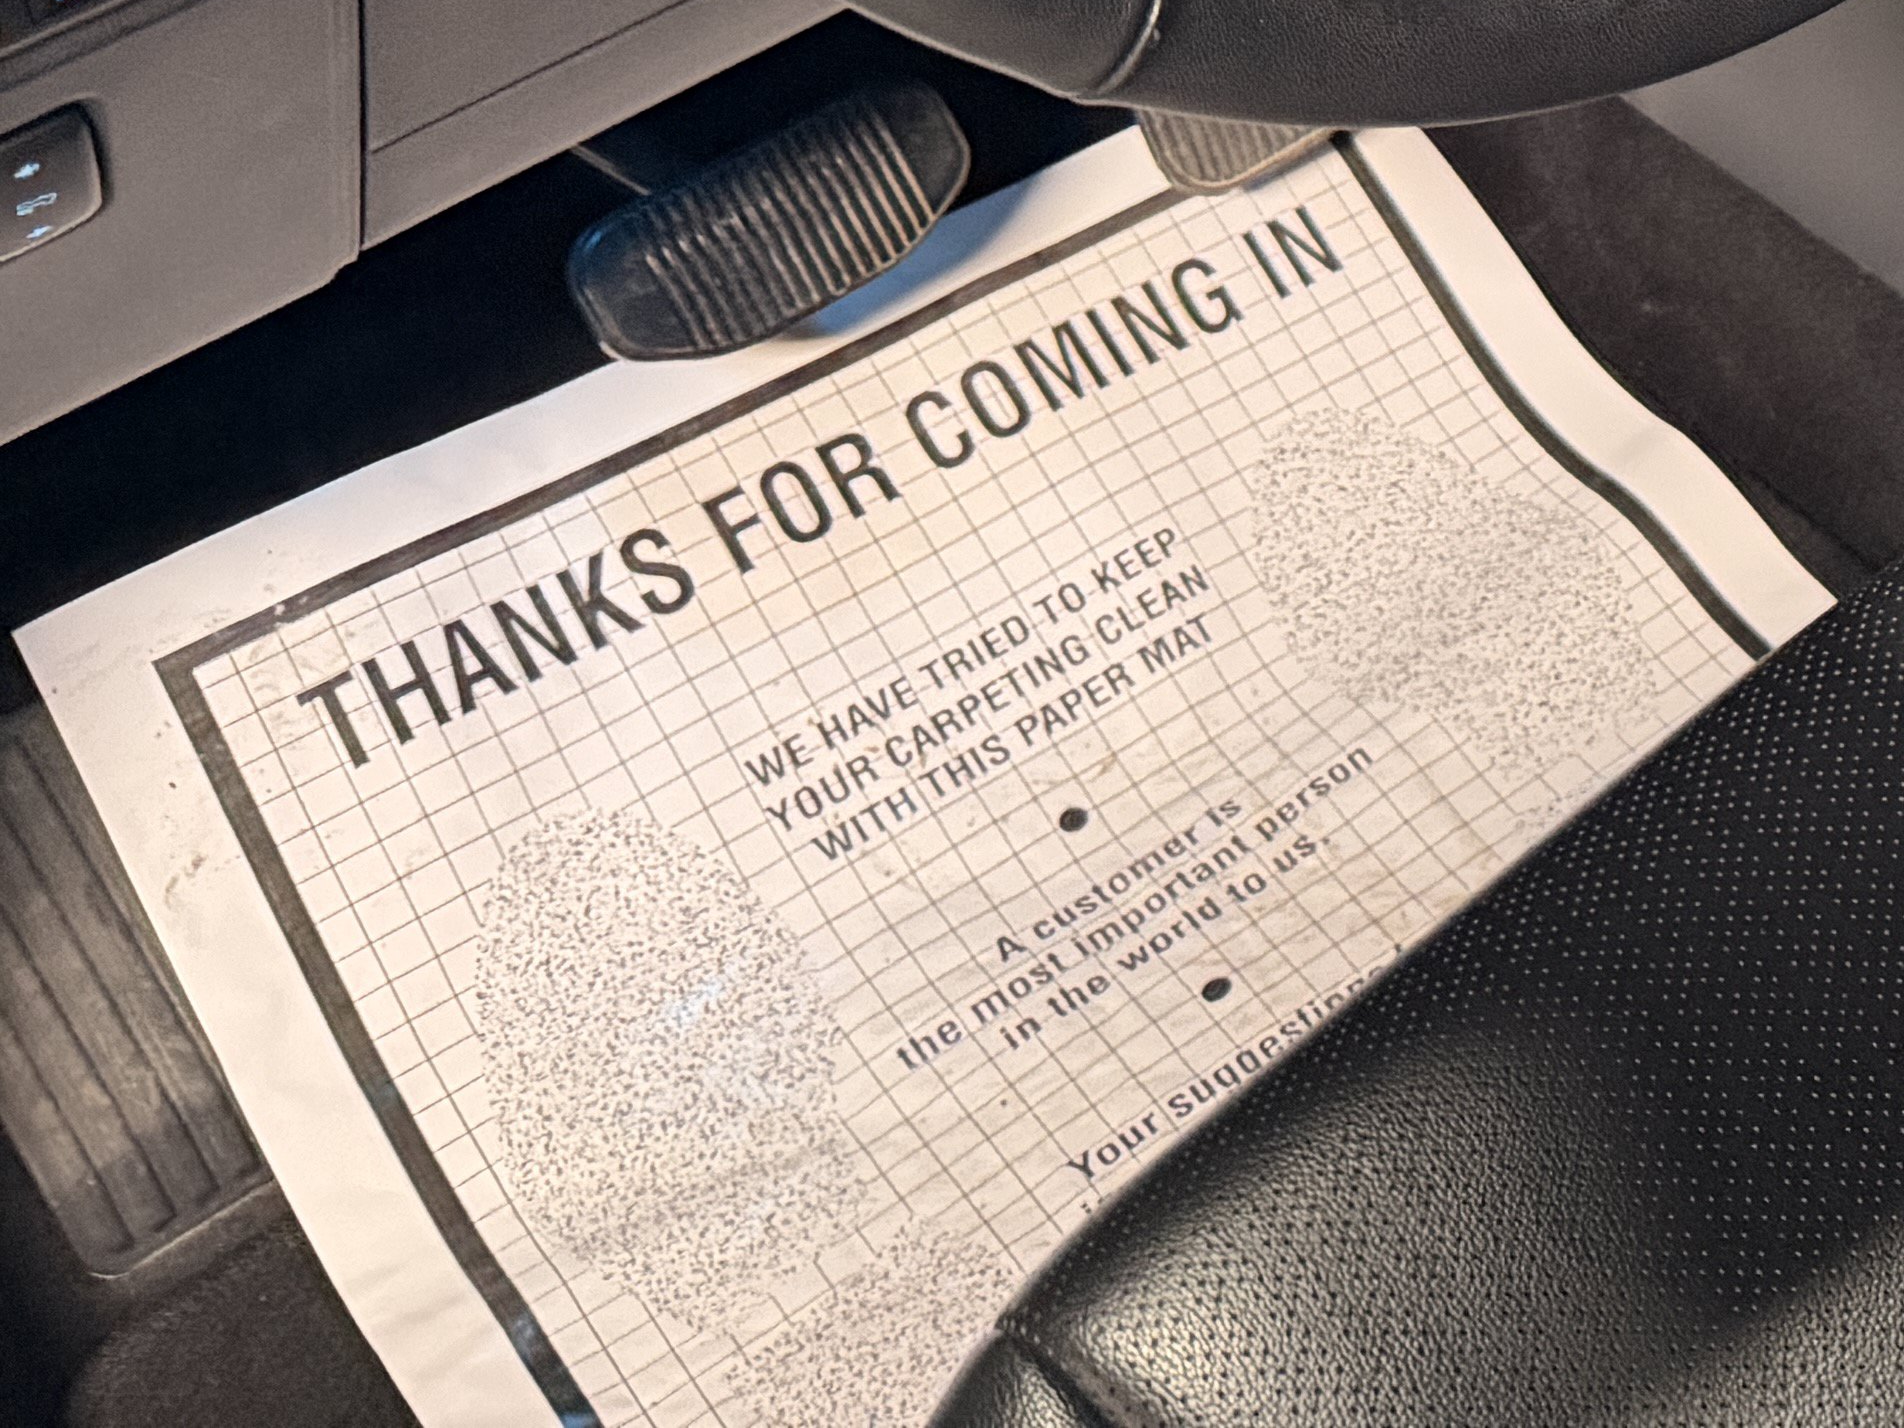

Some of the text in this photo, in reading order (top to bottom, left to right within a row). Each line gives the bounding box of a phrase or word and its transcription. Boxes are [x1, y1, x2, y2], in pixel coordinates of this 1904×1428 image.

[299, 204, 1344, 769] THANKS FOR COMING IN
[744, 528, 1176, 787] WE HAVE TRIED TO KEEP
[766, 565, 1211, 832] YOUR CARPETING CLEAN
[811, 612, 1213, 861] WITH THIS PAPER MAT
[896, 747, 1374, 1070] the most important person
[996, 799, 1242, 962] A customer is
[1000, 1016, 1042, 1050] in
[1047, 973, 1111, 1017] the
[1117, 896, 1223, 972] world
[1225, 872, 1267, 903] to
[1068, 965, 1384, 1180] Your suggesti
